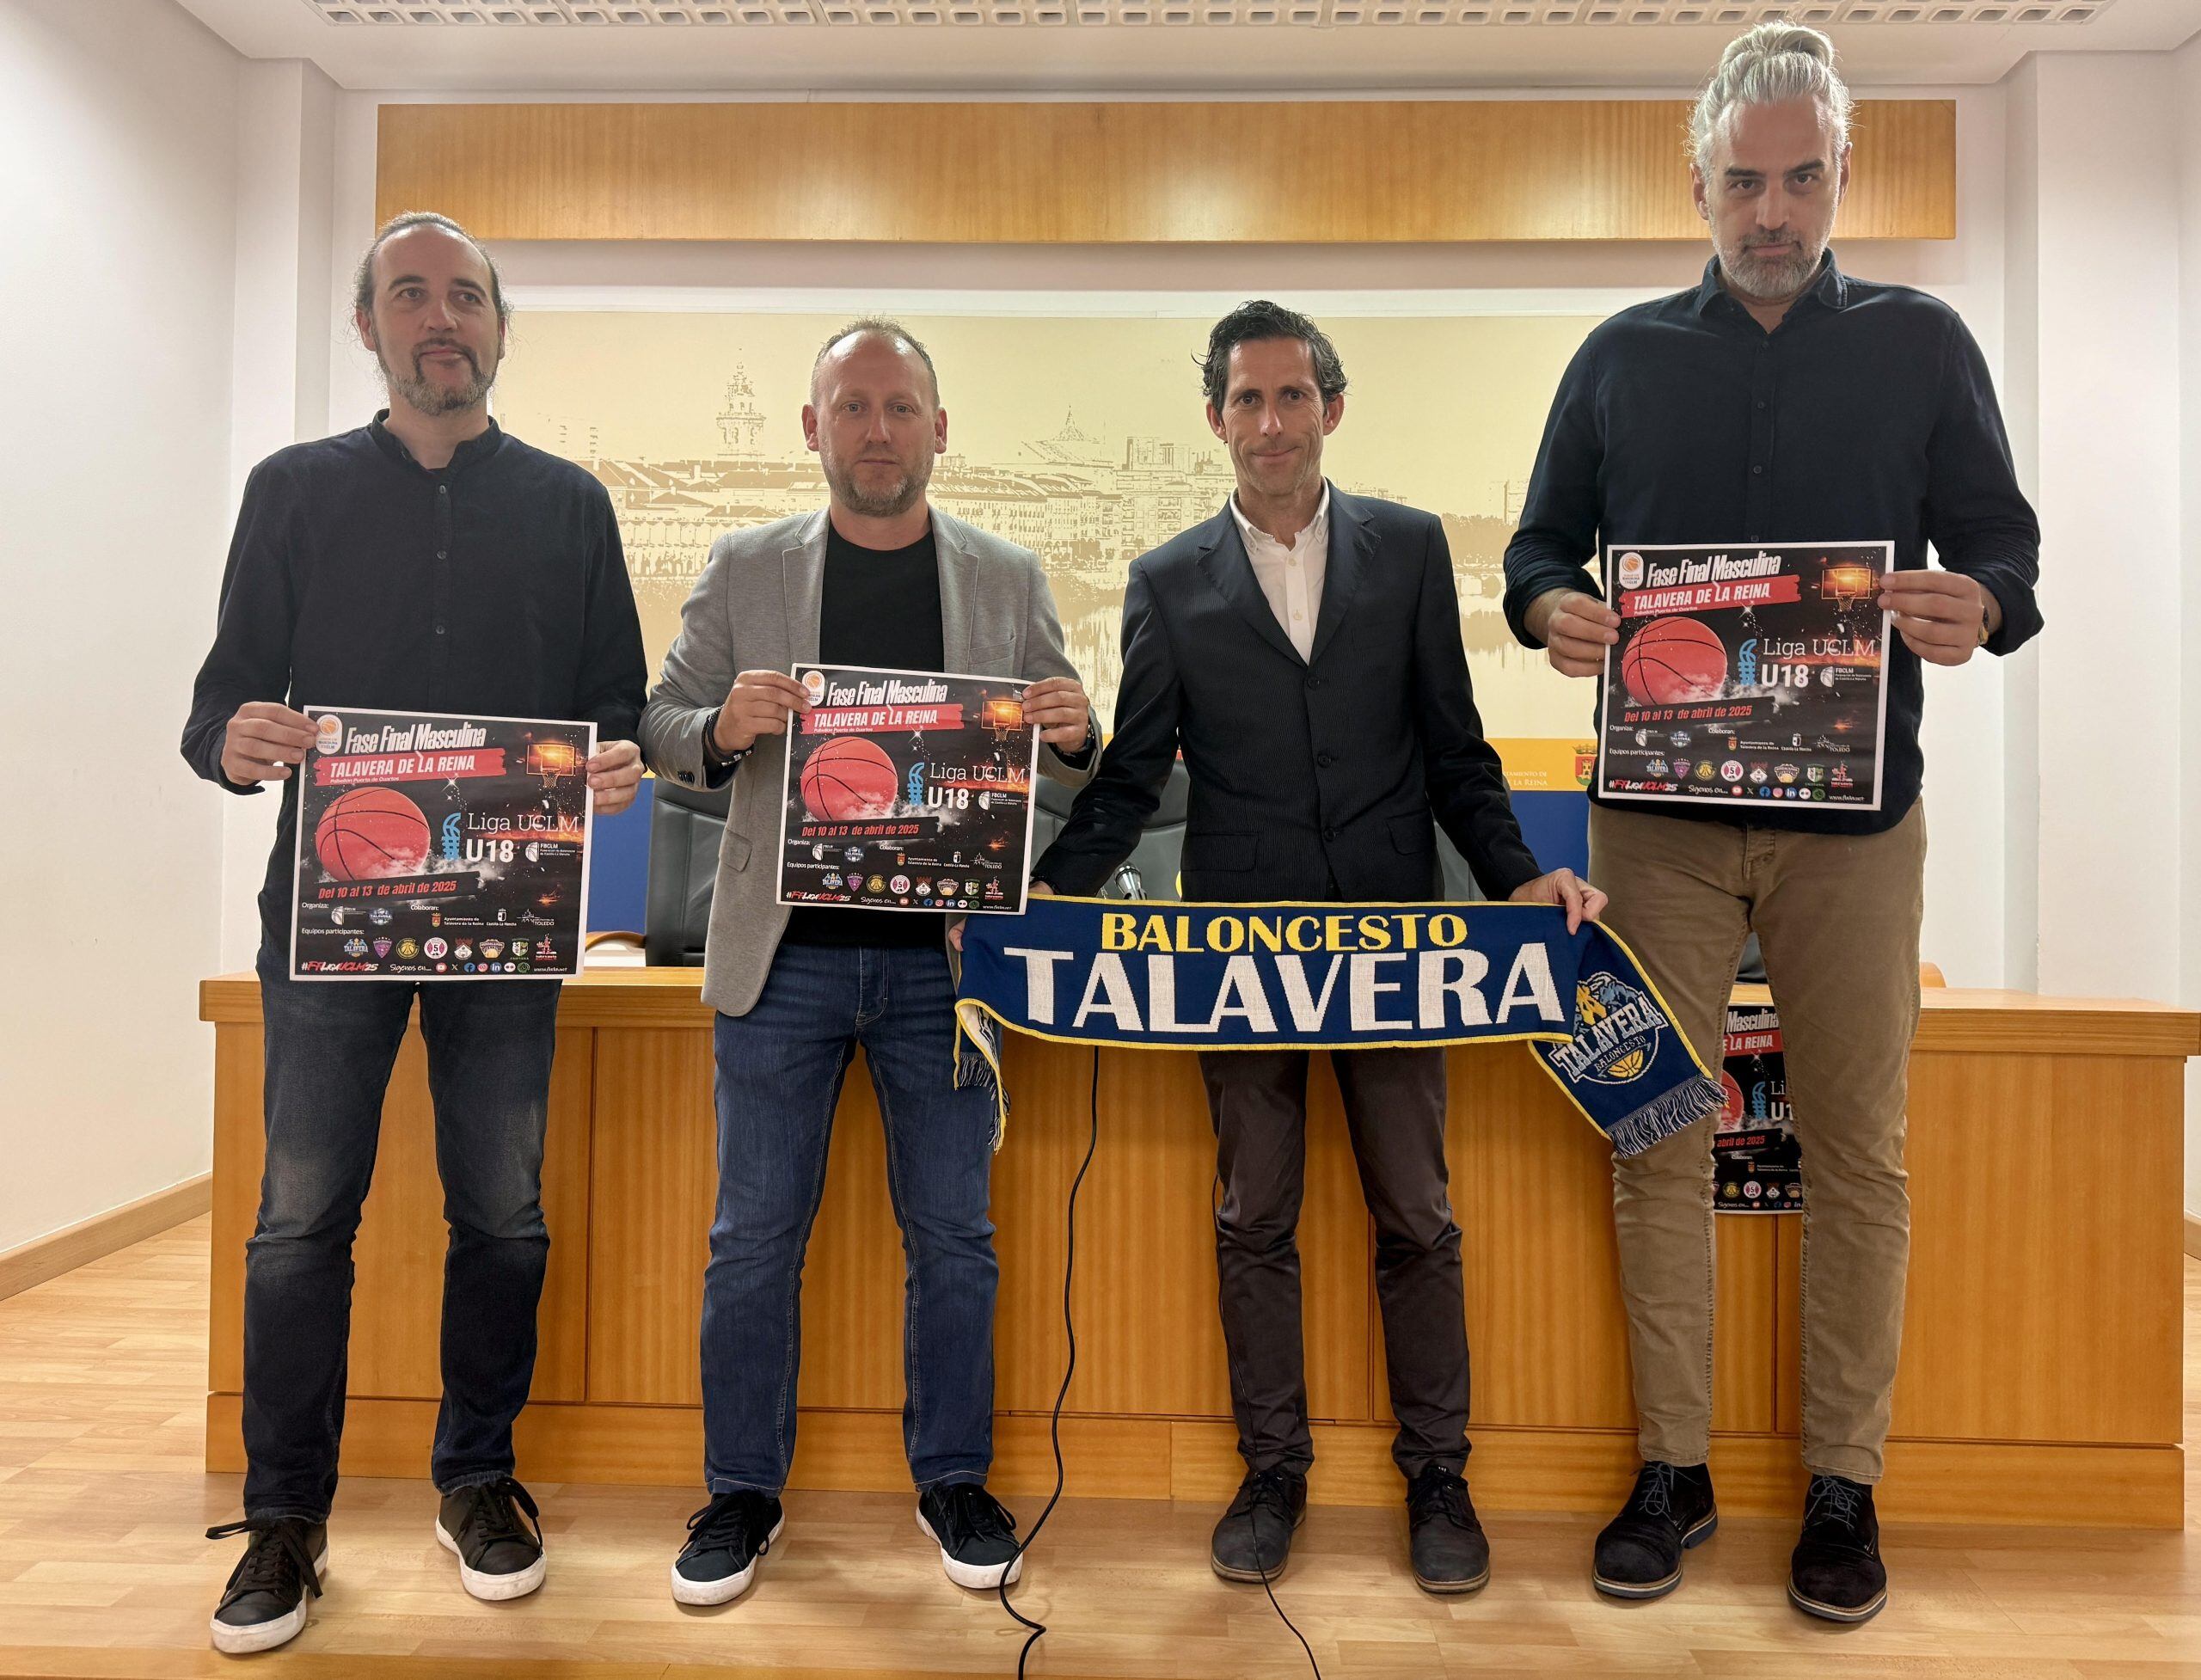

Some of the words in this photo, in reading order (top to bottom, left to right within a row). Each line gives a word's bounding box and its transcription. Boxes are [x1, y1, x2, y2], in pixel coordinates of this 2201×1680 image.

[1646, 563, 1677, 588] Fase
[1678, 555, 1713, 585] Final
[1712, 551, 1781, 581] Masculina
[1634, 592, 1692, 610] TALAVERA
[1695, 589, 1712, 604] DE
[1714, 586, 1729, 602] LA
[1733, 583, 1770, 599] REINA
[1763, 638, 1806, 659] Liga
[1812, 639, 1876, 657] UCLM
[1761, 664, 1809, 688] U18
[826, 682, 855, 706] Fase
[855, 681, 888, 705] Final
[886, 679, 948, 704] Masculina
[813, 713, 867, 727] TALAVERA
[872, 712, 886, 726] DE
[889, 710, 903, 725] LA
[904, 709, 938, 724] REINA
[1624, 711, 1638, 722] Del
[1641, 710, 1651, 721] 10
[1652, 710, 1661, 721] al
[1664, 709, 1673, 720] 13
[1677, 708, 1689, 720] de
[1690, 706, 1713, 719] abril
[1714, 706, 1726, 717] de
[1728, 705, 1752, 716] 2025
[344, 727, 380, 755] Fase
[378, 724, 415, 752] Final
[414, 721, 487, 751] Masculina
[329, 759, 394, 778] TALAVERA
[397, 758, 414, 774] DE
[418, 756, 433, 773] LA
[438, 755, 475, 772] REINA
[930, 763, 966, 783] Liga
[972, 765, 1026, 784] UCLM
[928, 787, 969, 810] U18
[467, 812, 511, 835] Liga
[517, 814, 579, 833] UCLM
[801, 826, 816, 837] Del
[818, 826, 827, 837] 10
[828, 825, 837, 836] al
[839, 825, 848, 836] 13
[851, 825, 863, 836] de
[864, 824, 884, 835] abril
[885, 825, 896, 834] de
[898, 824, 919, 834] 2025
[466, 838, 513, 863] U18
[318, 887, 334, 899] Del
[337, 886, 347, 898] 10
[349, 886, 359, 898] al
[362, 886, 373, 897] 13
[377, 885, 389, 896] de
[392, 882, 415, 895] abril
[417, 882, 429, 894] de
[431, 880, 457, 892] 2025
[1101, 913, 1468, 953] BALONCESTO
[1003, 942, 1566, 1033] TALAVERA
[1726, 1008, 1779, 1033] Masculina
[1554, 996, 1666, 1077] TALAVERA
[1730, 1036, 1742, 1051] LA
[1744, 1034, 1773, 1050] REINA
[1594, 1034, 1646, 1072] BALONCESTO
[1770, 1080, 1786, 1095] Li
[1771, 1101, 1793, 1121] U1
[1717, 1137, 1734, 1148] abril
[1735, 1137, 1745, 1146] de
[1746, 1135, 1765, 1145] 2025
